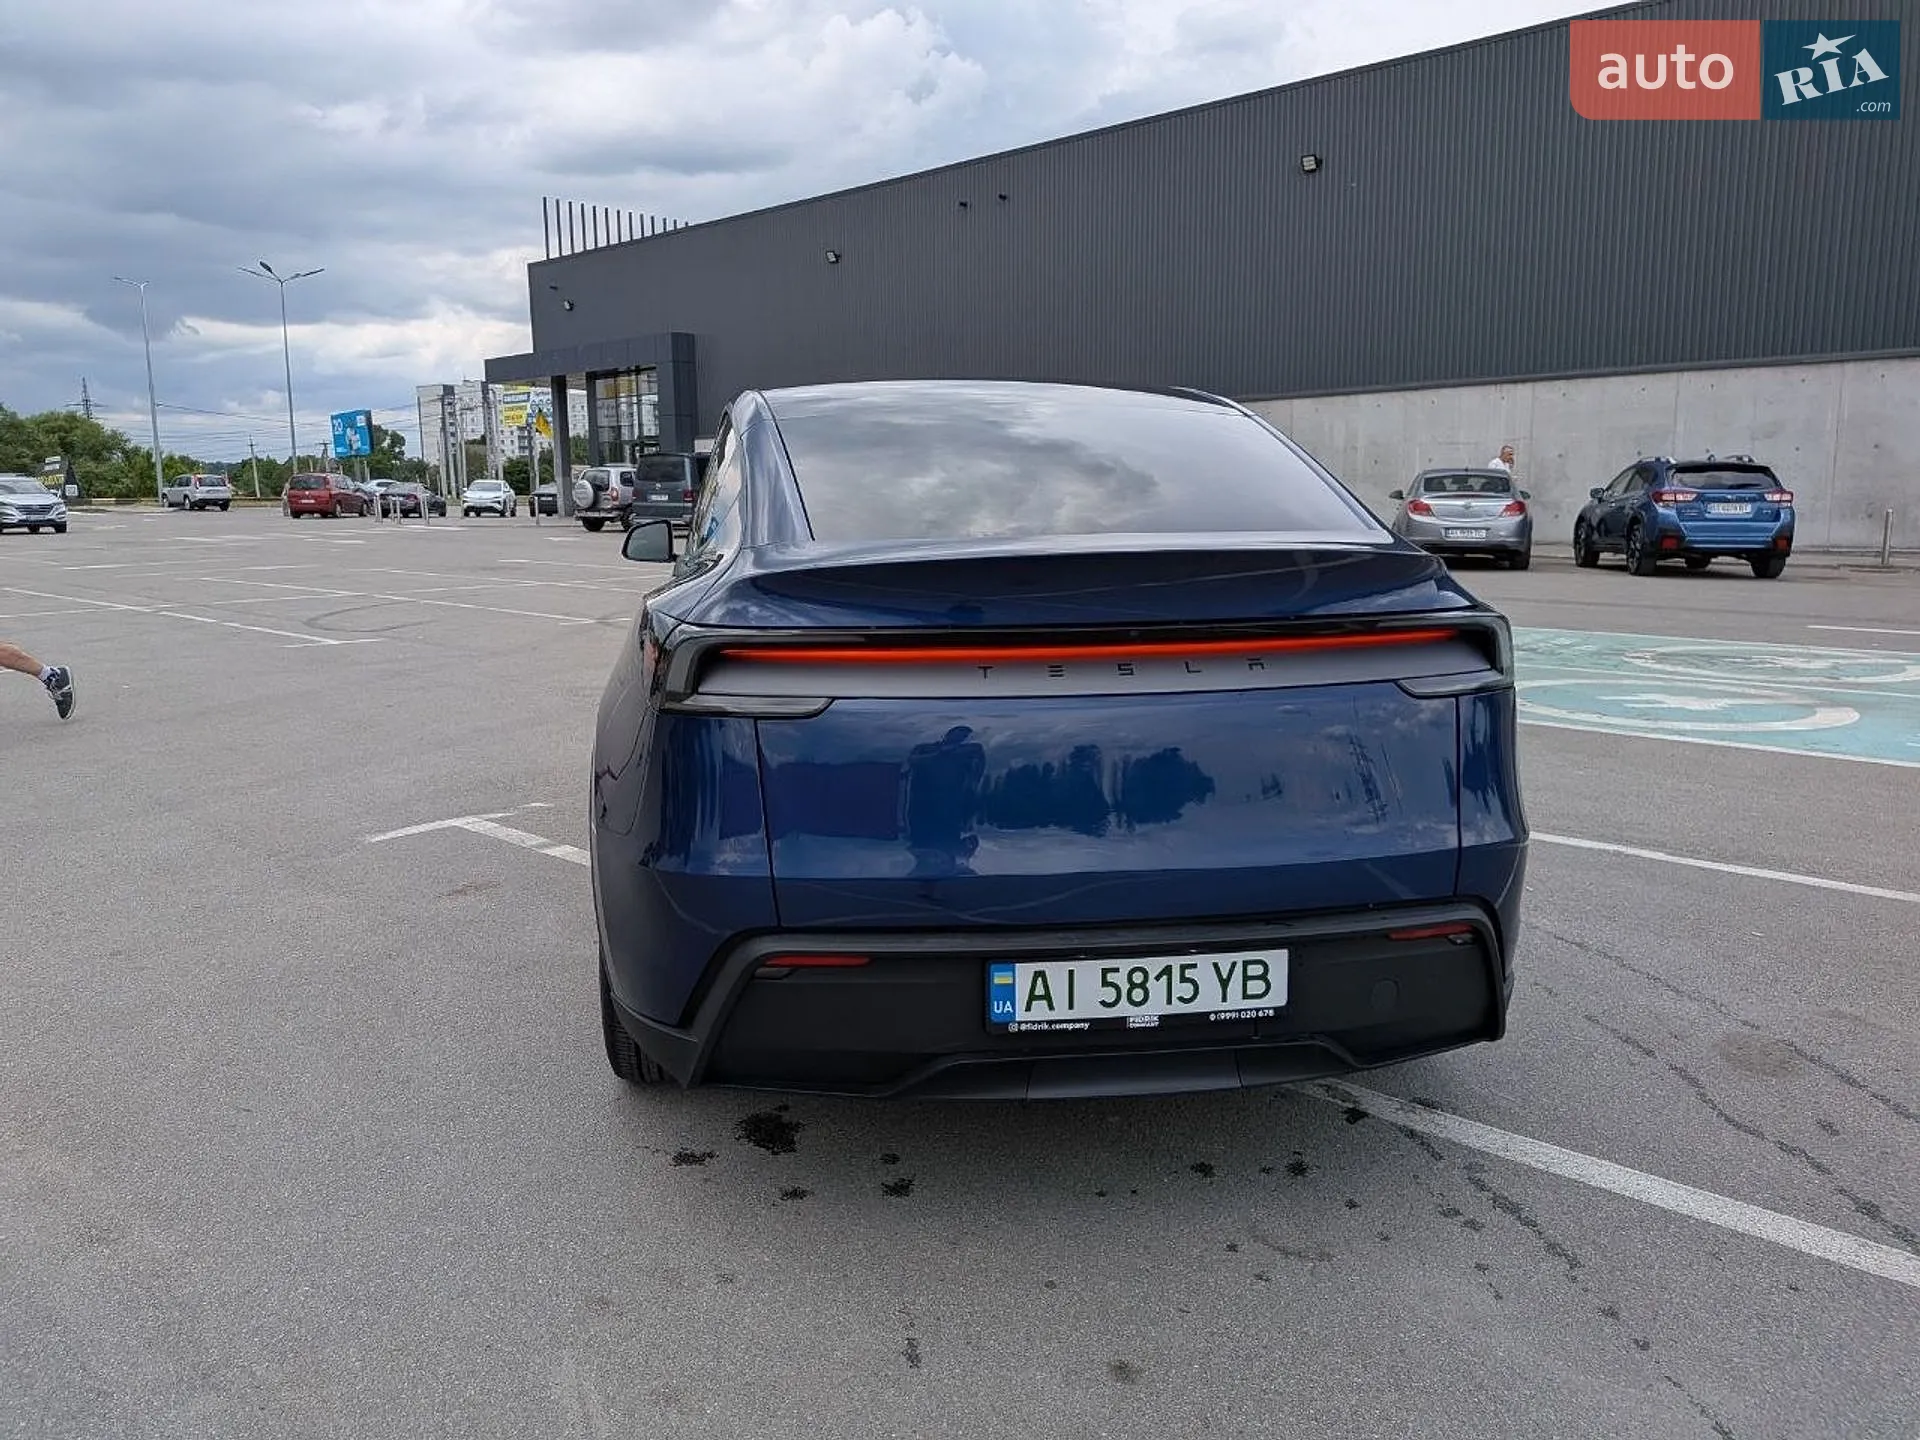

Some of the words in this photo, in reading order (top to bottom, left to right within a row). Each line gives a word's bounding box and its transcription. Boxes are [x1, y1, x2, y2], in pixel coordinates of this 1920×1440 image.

[978, 658, 1265, 680] TESLA
[1024, 969, 1076, 1012] AI
[1098, 963, 1200, 1008] 5815
[1212, 959, 1272, 1003] YB
[994, 1001, 1013, 1014] UA
